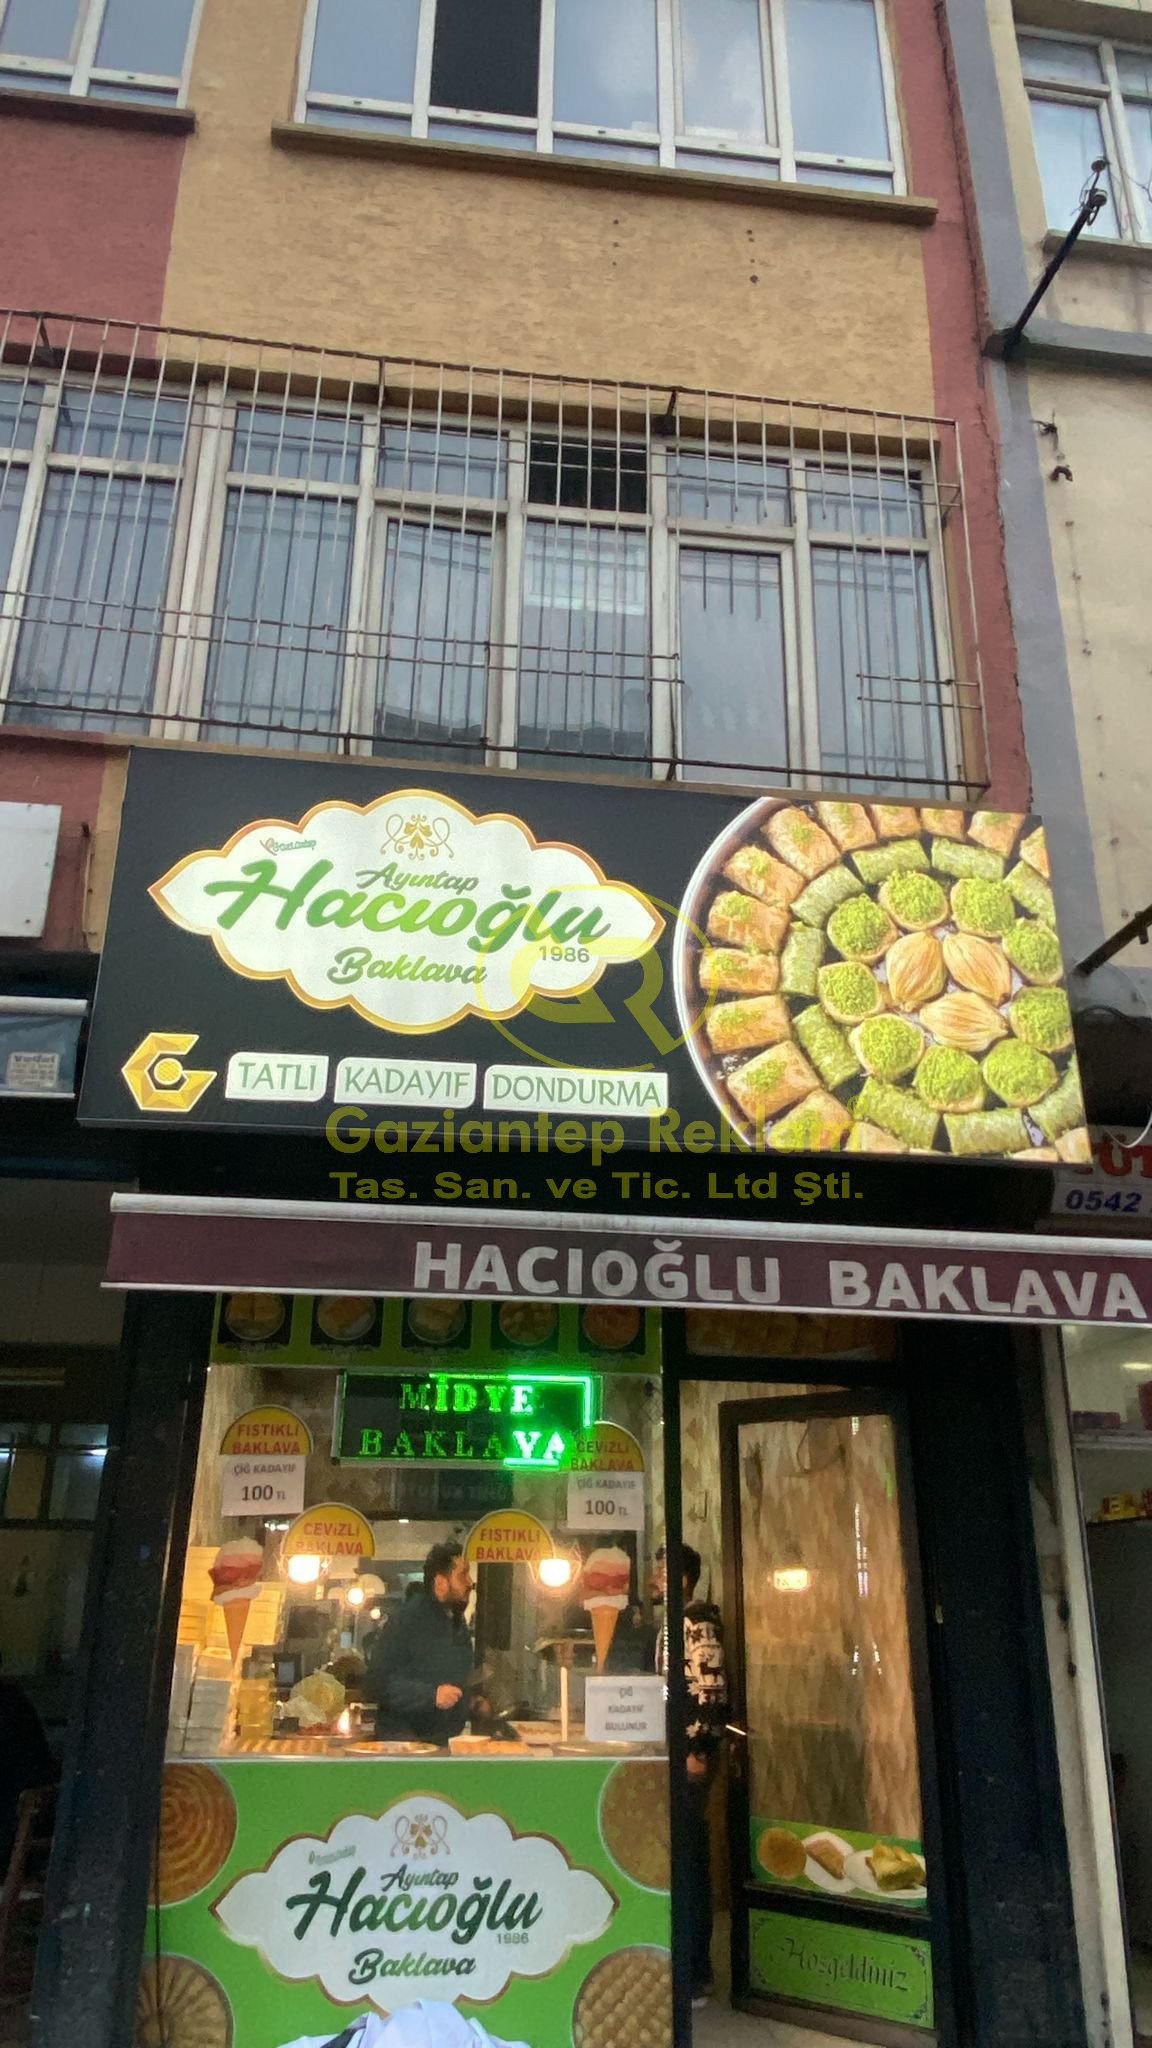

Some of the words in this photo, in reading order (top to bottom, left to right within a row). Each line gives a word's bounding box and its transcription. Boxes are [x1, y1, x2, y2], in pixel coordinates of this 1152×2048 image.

[326, 946, 487, 985] Baklava
[538, 945, 590, 963] 1986
[238, 1062, 317, 1092] TATLI
[344, 1067, 471, 1099] KADAYIF
[492, 1074, 662, 1108] DONDURMA
[1065, 1189, 1142, 1213] 0542
[413, 1238, 781, 1304] HACIOĞLU
[828, 1259, 1147, 1318] BAKLAVA
[231, 1441, 300, 1455] BAKLAVA
[359, 1427, 567, 1460] BAKLAVA
[241, 1484, 274, 1502] 100
[584, 1500, 616, 1516] 100
[496, 1933, 529, 1945] 1986
[348, 1948, 477, 1985] Baklava
